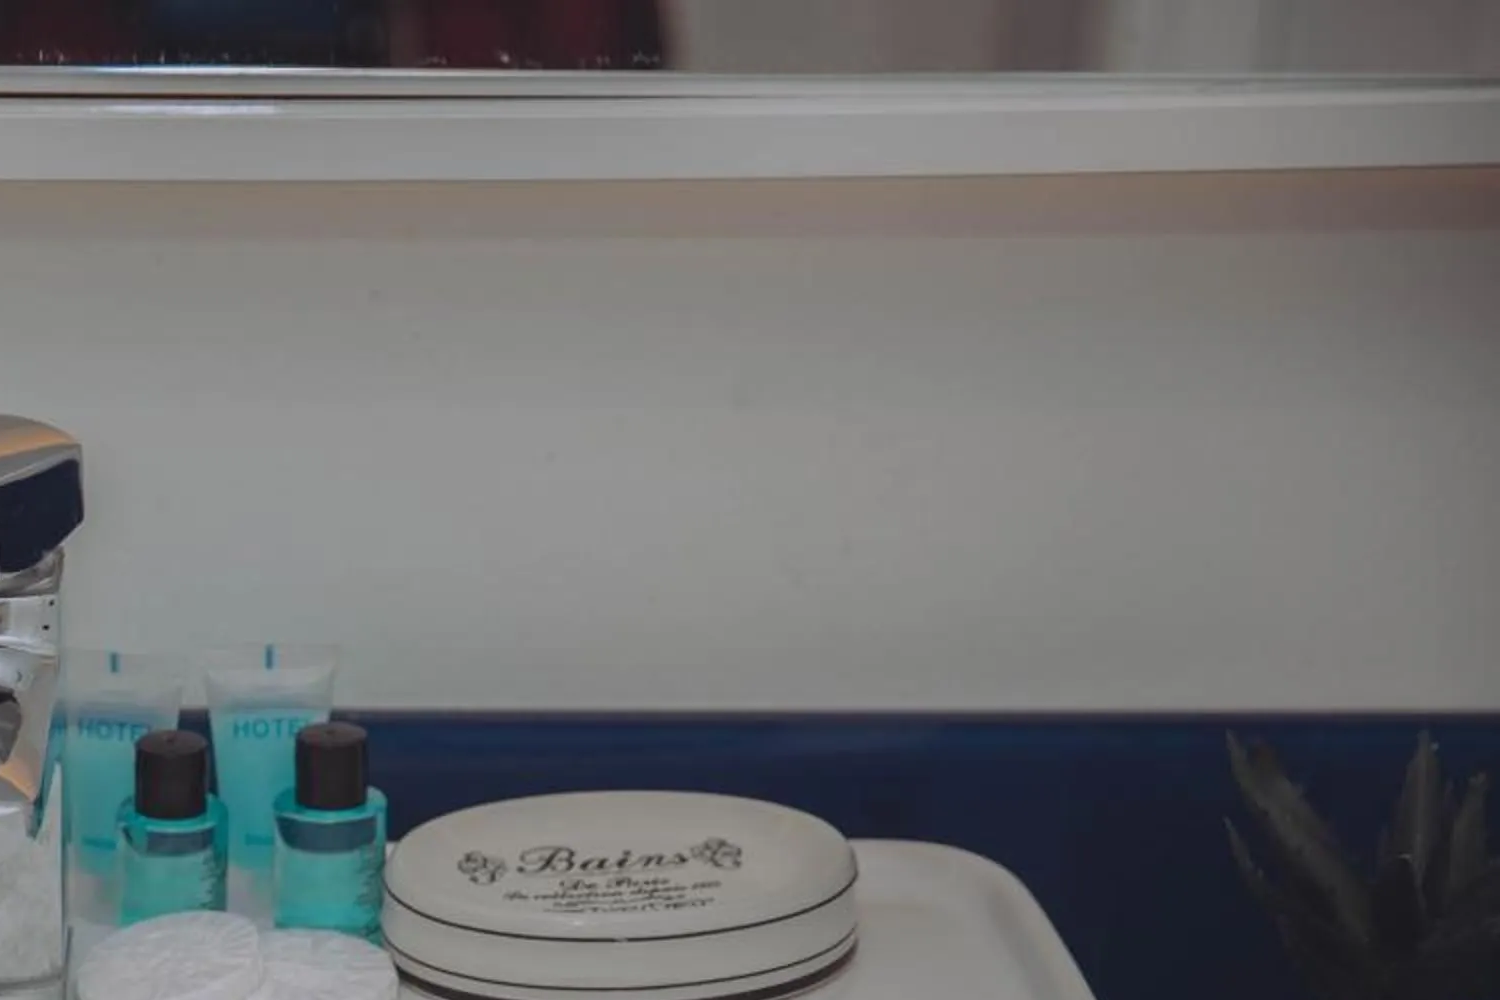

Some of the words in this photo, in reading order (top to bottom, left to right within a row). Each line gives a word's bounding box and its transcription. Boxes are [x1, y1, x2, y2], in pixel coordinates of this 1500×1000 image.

[78, 717, 150, 742] HOTE
[233, 717, 304, 739] HOTE
[517, 846, 689, 874] Bains
